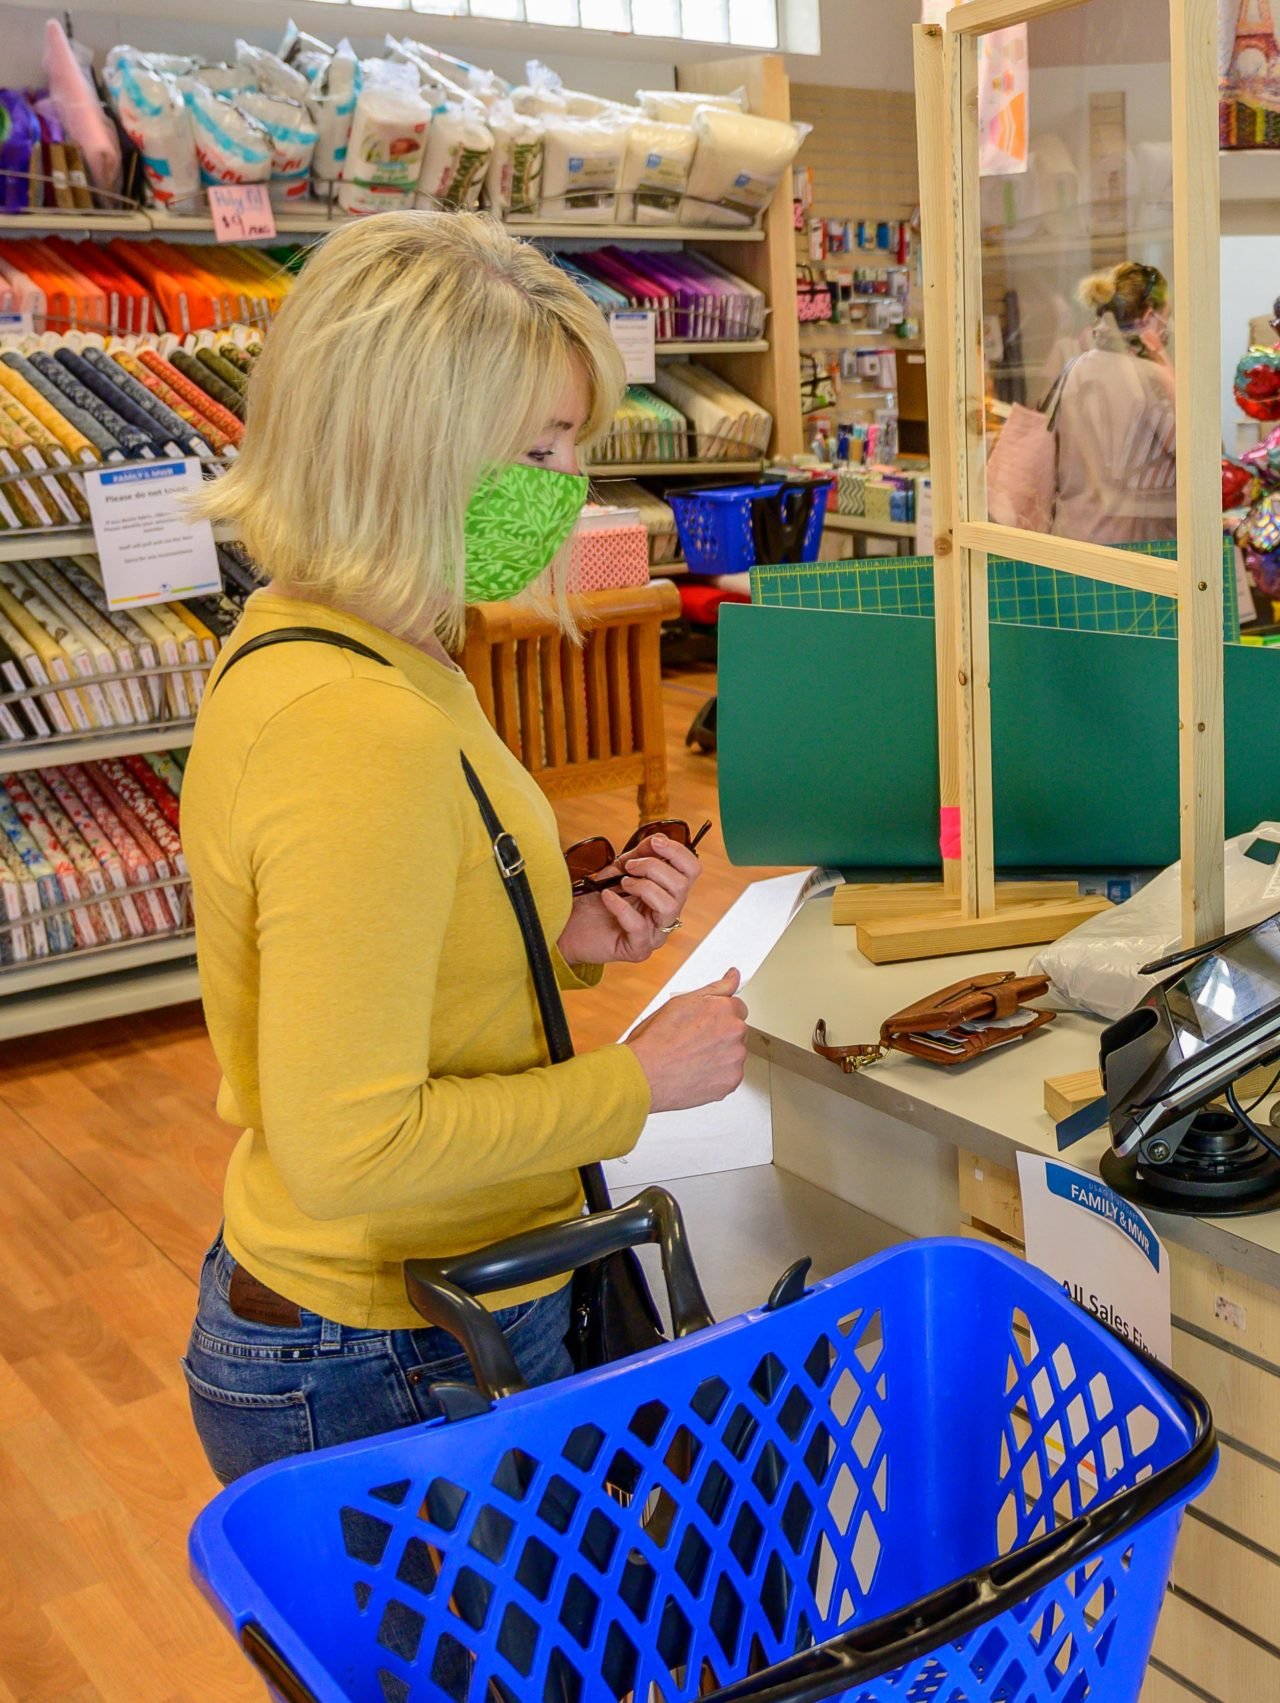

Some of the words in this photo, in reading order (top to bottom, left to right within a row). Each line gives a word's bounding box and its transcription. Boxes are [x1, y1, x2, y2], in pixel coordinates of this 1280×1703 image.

[1071, 1184, 1118, 1222] FAMILY
[1119, 1210, 1127, 1229] &
[1128, 1218, 1150, 1256] MWR
[1089, 1294, 1129, 1340] Sales
